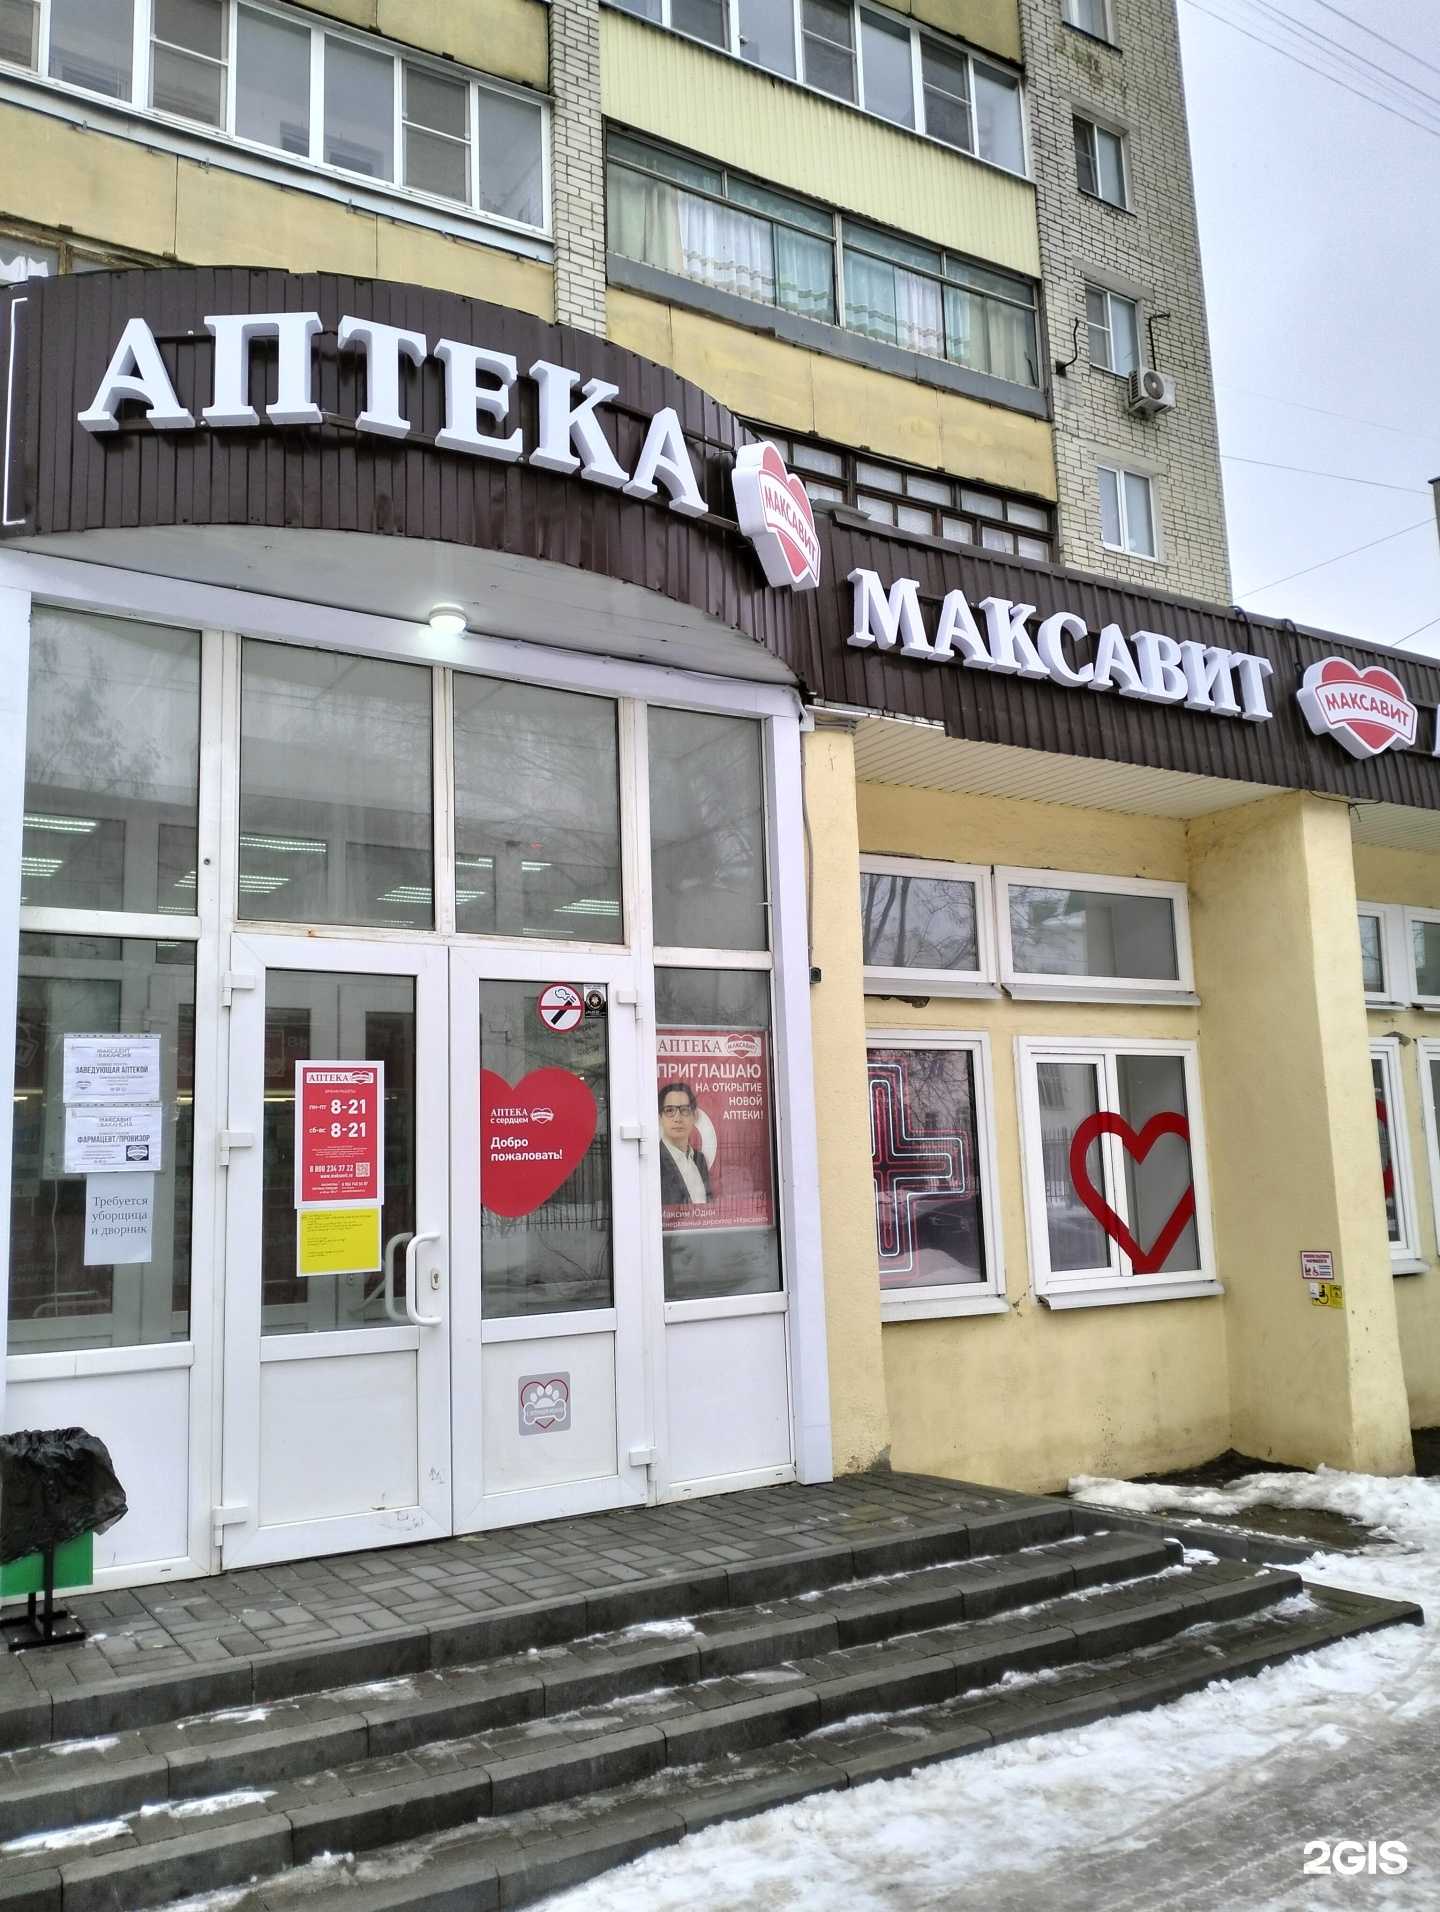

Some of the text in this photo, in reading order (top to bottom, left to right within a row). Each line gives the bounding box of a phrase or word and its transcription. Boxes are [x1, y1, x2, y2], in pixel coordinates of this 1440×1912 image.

[77, 312, 710, 518] АПТЕКА
[764, 485, 817, 562] МАКСАВИТ
[846, 567, 1275, 722] МАКСАВИТ
[1324, 692, 1409, 727] МАКСАВИТ
[658, 1039, 721, 1053] АПТЕКА
[75, 1065, 149, 1074] ЗАВЕДУЮЩАЯ АПТЕКОЙ
[657, 1063, 762, 1079] ПРИГЛАШАЮ
[308, 1073, 350, 1082] АПТЕКА
[695, 1082, 763, 1093] НА ОТКРЫТИЕ
[728, 1094, 763, 1106] НОВОЙ
[330, 1098, 367, 1115] 8-21
[490, 1108, 529, 1117] АПТЕКА
[723, 1109, 764, 1120] АПТЕКИ!
[496, 1117, 529, 1125] сердцем
[330, 1122, 367, 1138] 8-21
[77, 1134, 151, 1144] ФАРМАЦЕВТ/ПРОВИЗОР
[490, 1136, 529, 1150] Добро
[490, 1148, 563, 1162] пожаловать!
[92, 1196, 149, 1208] Требуется
[92, 1210, 148, 1222] уборщица
[101, 1226, 148, 1237] дворник
